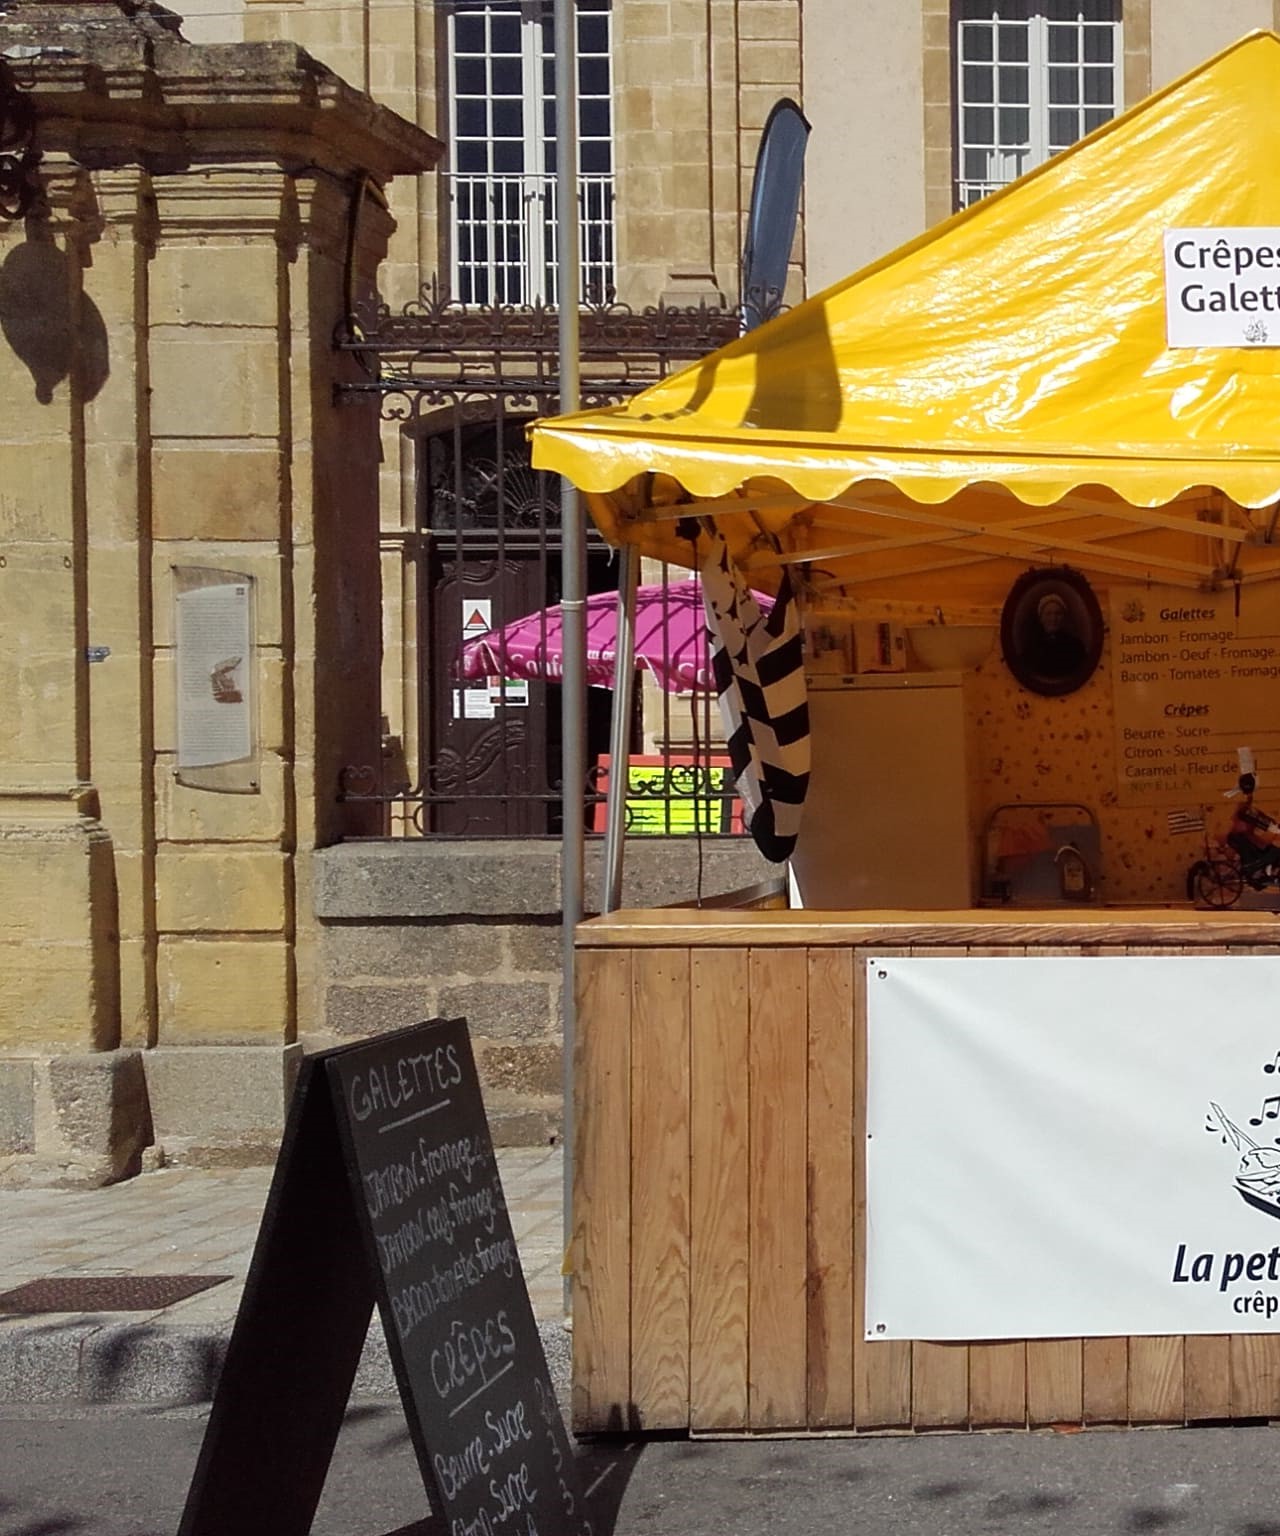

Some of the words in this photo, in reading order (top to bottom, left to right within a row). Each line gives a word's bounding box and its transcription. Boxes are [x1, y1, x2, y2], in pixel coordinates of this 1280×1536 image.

[1159, 608, 1215, 622] Galettes
[1120, 632, 1168, 645] Jambon
[1179, 629, 1235, 644] Fromage
[1120, 651, 1170, 664] Jambon
[1180, 648, 1211, 661] Oeuf
[1220, 647, 1276, 660] Fromage
[1120, 670, 1159, 683] Bacon
[1169, 667, 1221, 681] Tomates
[1163, 702, 1210, 718] Crêpes
[1123, 727, 1166, 741] Beurre
[1175, 725, 1211, 738] Sucre
[1124, 746, 1163, 760] Citron
[1174, 744, 1209, 757] Sucre
[1125, 763, 1177, 778] Caramel
[1187, 762, 1219, 775] Fleur
[1221, 760, 1239, 773] de
[350, 1044, 463, 1121] GALETTES
[1172, 1243, 1213, 1284] La
[485, 1400, 533, 1455] Sucre
[489, 1462, 538, 1523] Sucre
